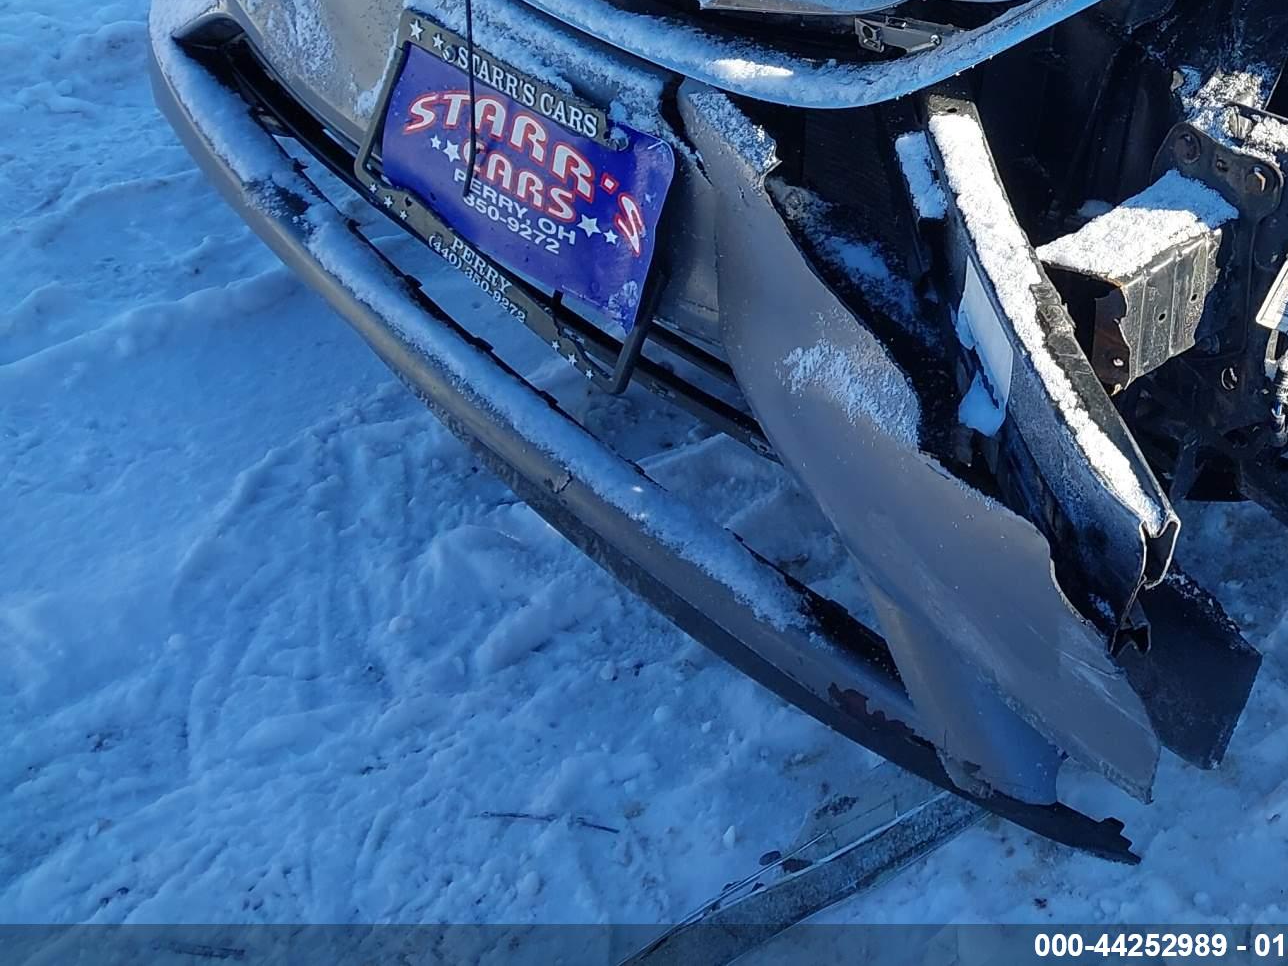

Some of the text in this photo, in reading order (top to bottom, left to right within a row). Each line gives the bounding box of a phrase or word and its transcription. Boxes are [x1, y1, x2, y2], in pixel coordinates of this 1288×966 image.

[456, 46, 598, 138] STARR'S CARS
[462, 138, 577, 222] CARS
[463, 192, 560, 255] 350-9272
[537, 217, 576, 245] OH
[428, 234, 527, 323] (440) 350-9272
[450, 236, 513, 294] PERRY
